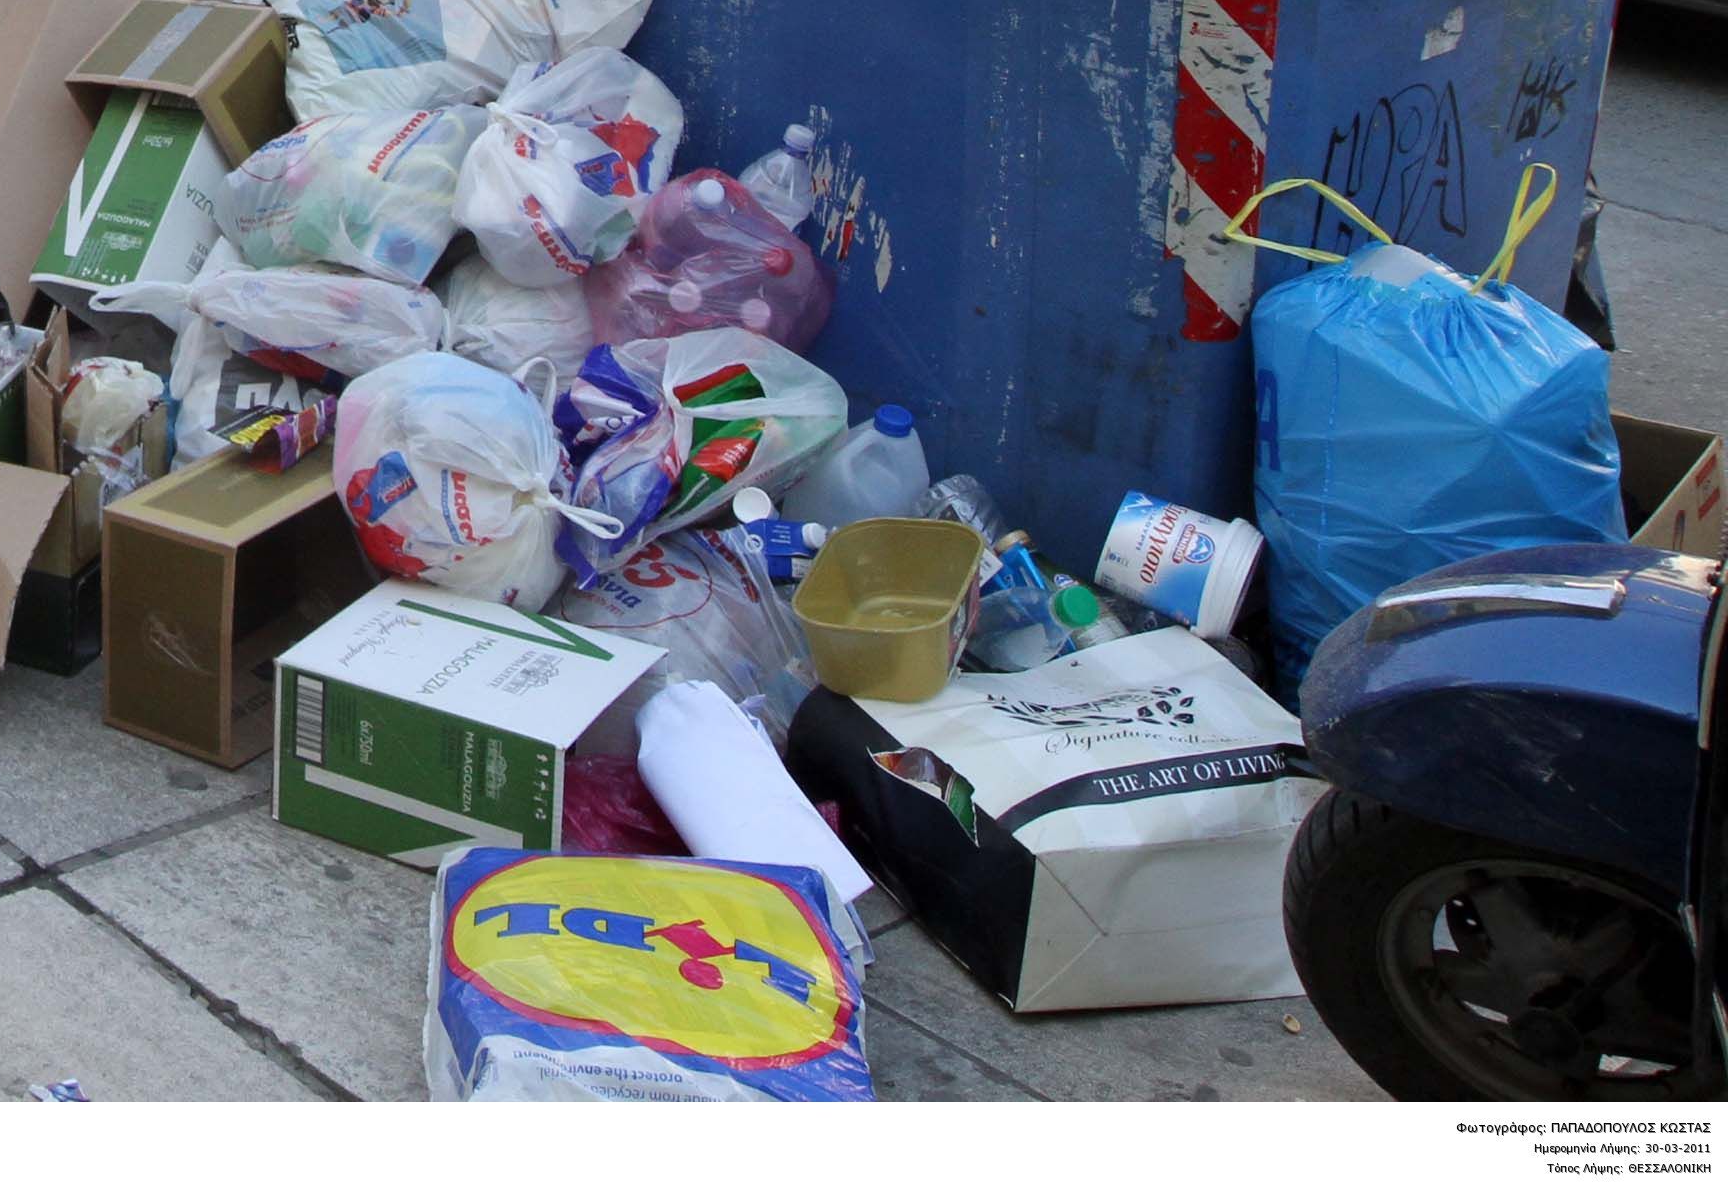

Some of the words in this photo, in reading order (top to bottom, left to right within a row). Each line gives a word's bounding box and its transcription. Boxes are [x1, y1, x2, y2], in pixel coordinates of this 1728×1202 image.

[96, 211, 152, 228] MALAGOUZIA
[416, 635, 500, 696] MALAGOUZIA
[359, 719, 374, 767] 6x750ml
[462, 731, 475, 813] MALAGOUZIA
[1092, 772, 1147, 798] THE
[1146, 765, 1192, 790] ART
[1192, 759, 1225, 783] OF
[1222, 751, 1286, 778] LIVING
[604, 1066, 629, 1080] the
[632, 1066, 683, 1086] protect
